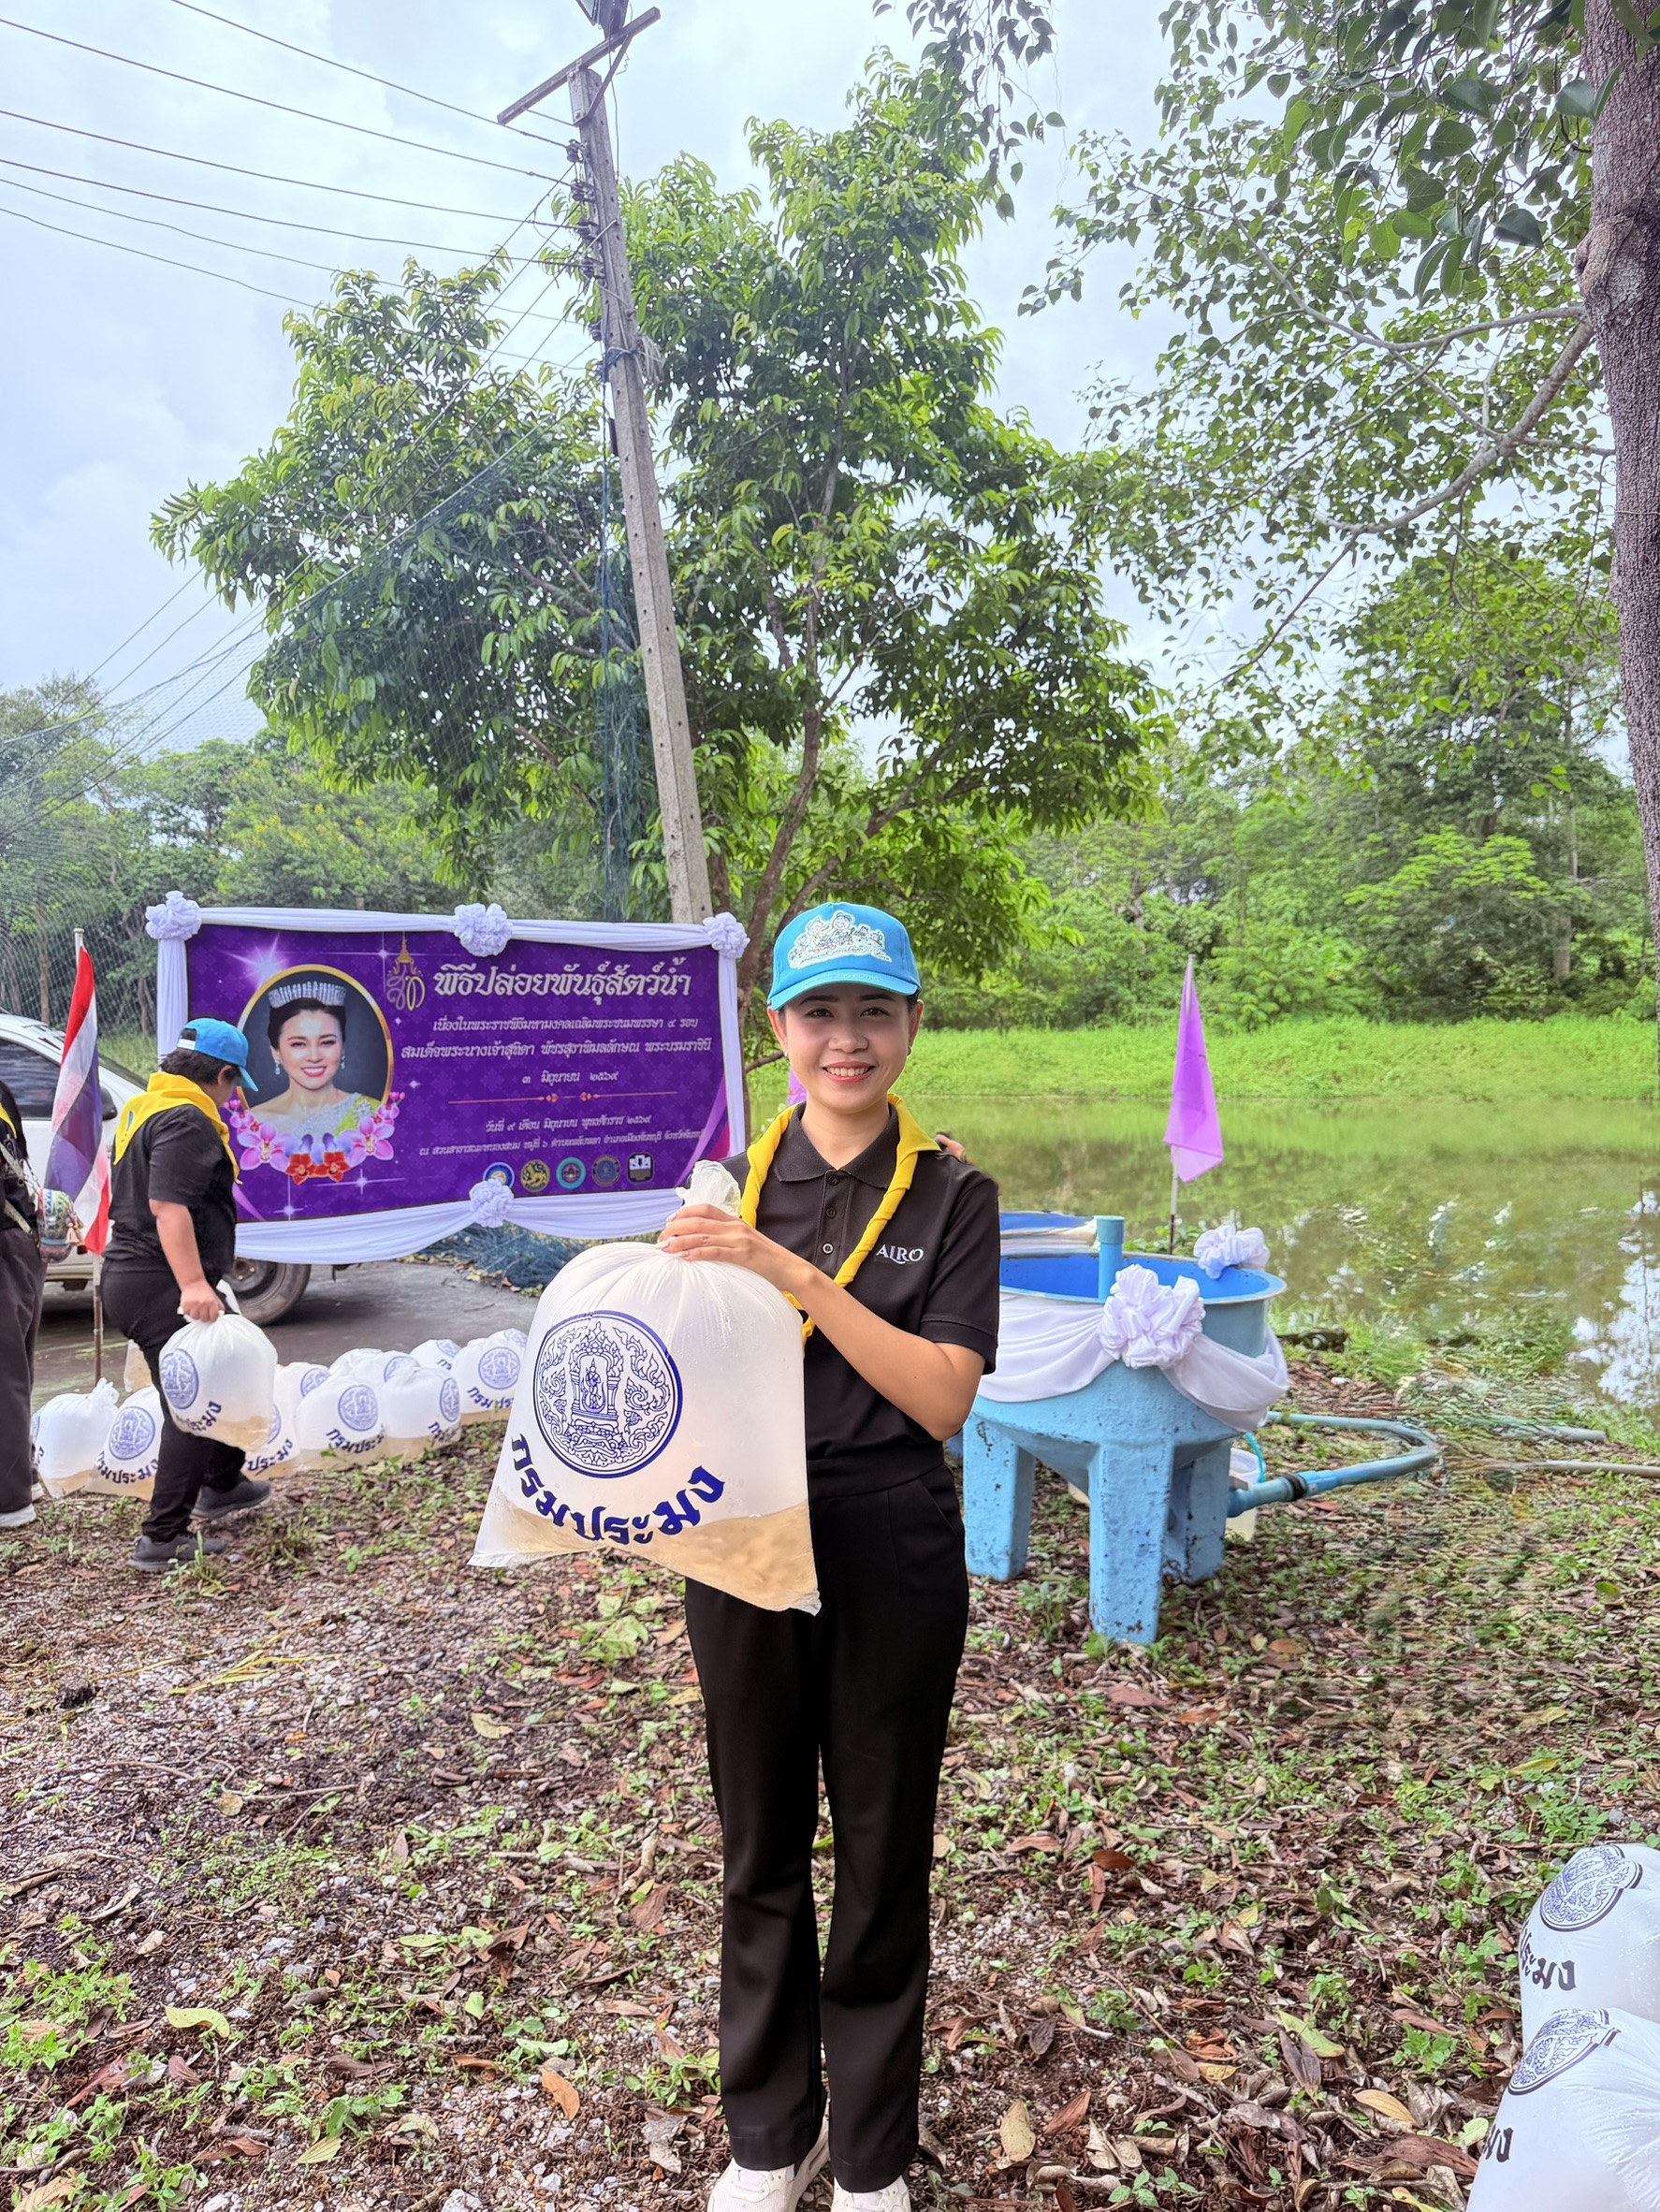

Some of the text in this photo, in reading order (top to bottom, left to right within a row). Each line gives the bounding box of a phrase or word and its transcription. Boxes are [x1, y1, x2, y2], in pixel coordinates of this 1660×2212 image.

[433, 956, 692, 1006] พิธีปล่อยพันธุ์สัตว์น้ำ
[679, 1017, 699, 1028] รอบ
[400, 1037, 712, 1060] สมเด็จพระนางเจ้าสุทิดา พัชรสุธาพิมลลักษณ พระบรมราชินี
[522, 1075, 531, 1084] ๓
[541, 1070, 580, 1086] มิถุนายน
[486, 1117, 505, 1133] วันที่
[543, 1117, 578, 1133] มิถุนายน
[876, 1244, 925, 1265] AIRO
[511, 1433, 726, 1546] กรมประมง
